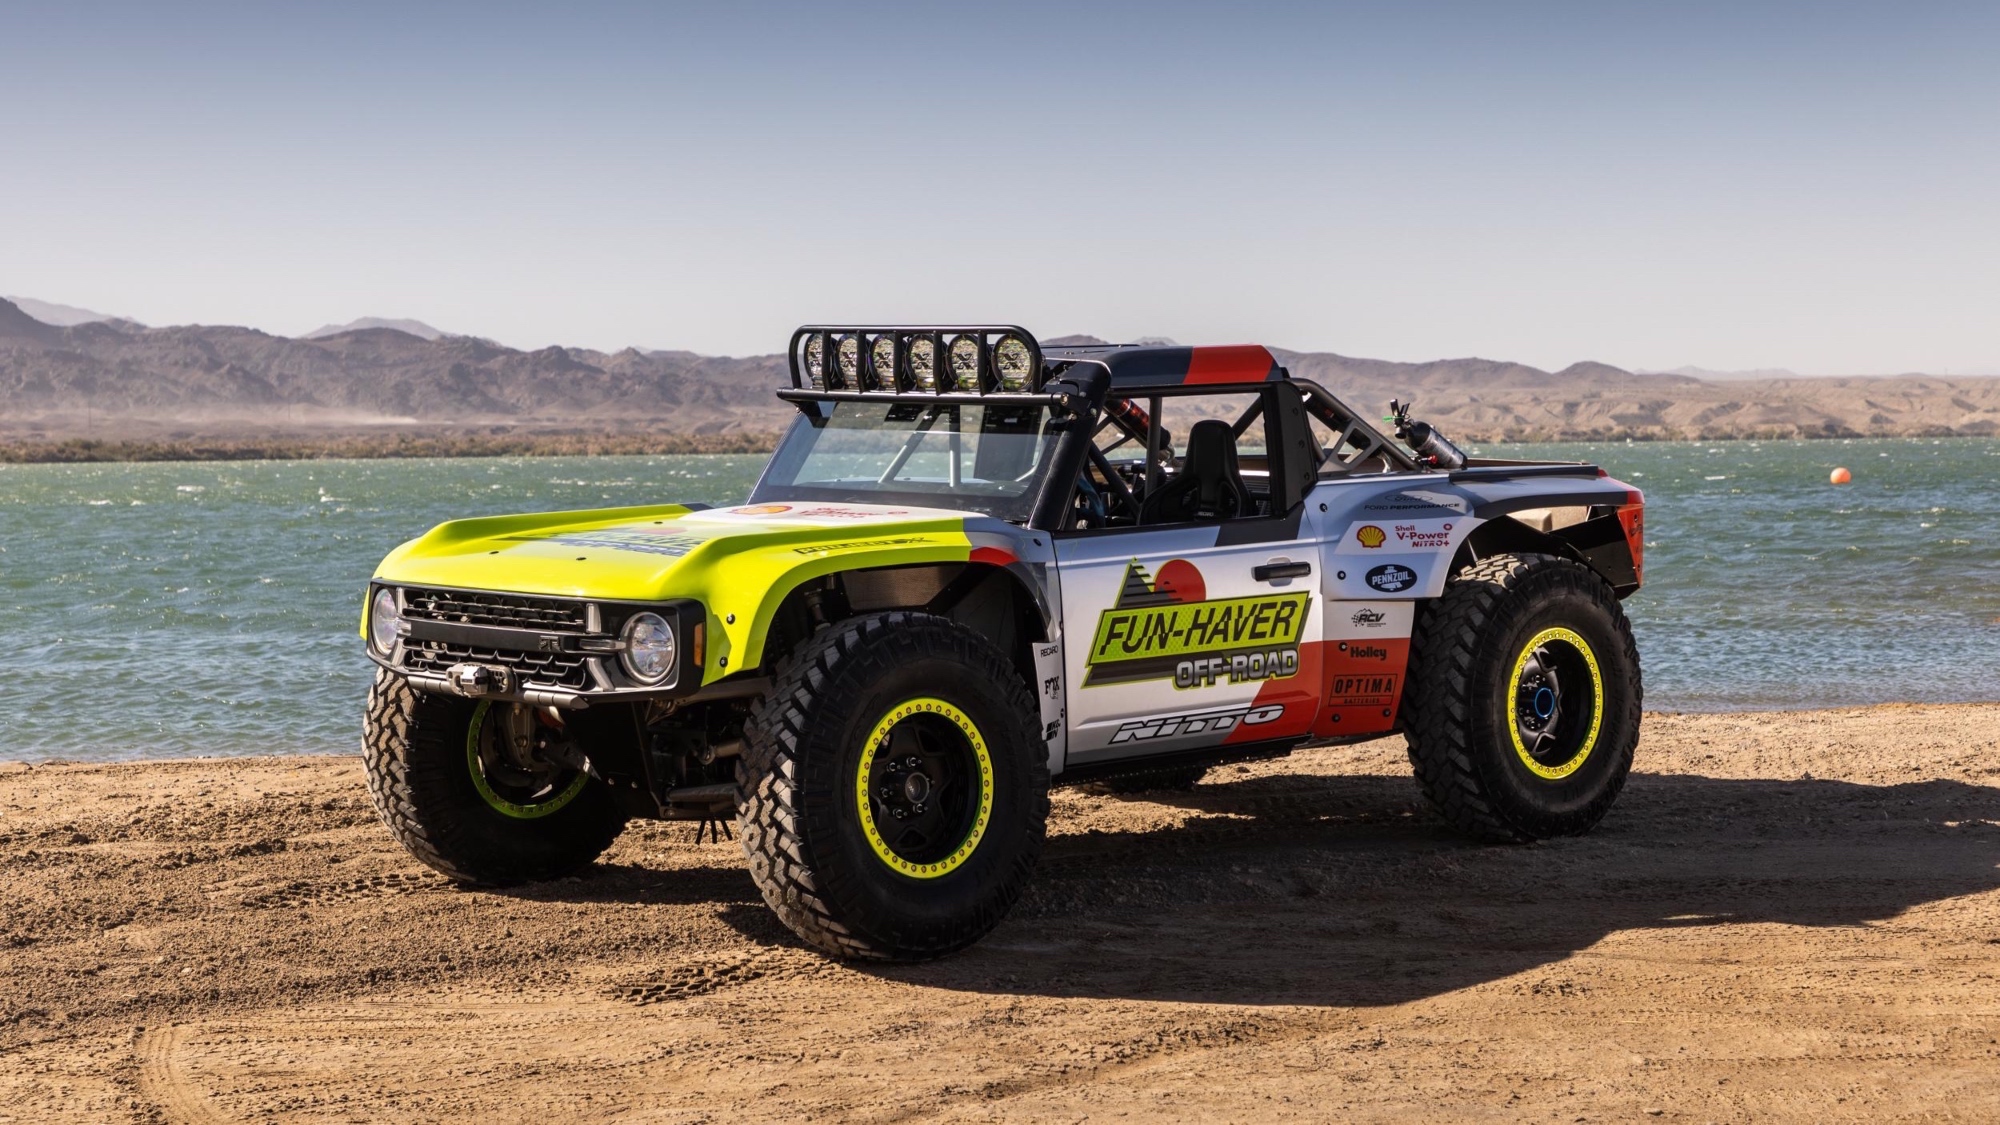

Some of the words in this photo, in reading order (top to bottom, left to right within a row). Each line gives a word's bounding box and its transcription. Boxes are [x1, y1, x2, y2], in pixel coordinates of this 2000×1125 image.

[1389, 502, 1460, 510] PERFORMANCE
[1396, 532, 1450, 541] V-Power
[1371, 571, 1411, 586] PENNZOIL
[1099, 600, 1299, 656] FUN-HAVER
[1040, 645, 1059, 658] RECARO
[1350, 646, 1387, 661] Holley
[1175, 649, 1299, 689] OFF-ROAD
[1334, 678, 1393, 695] OPTIMA
